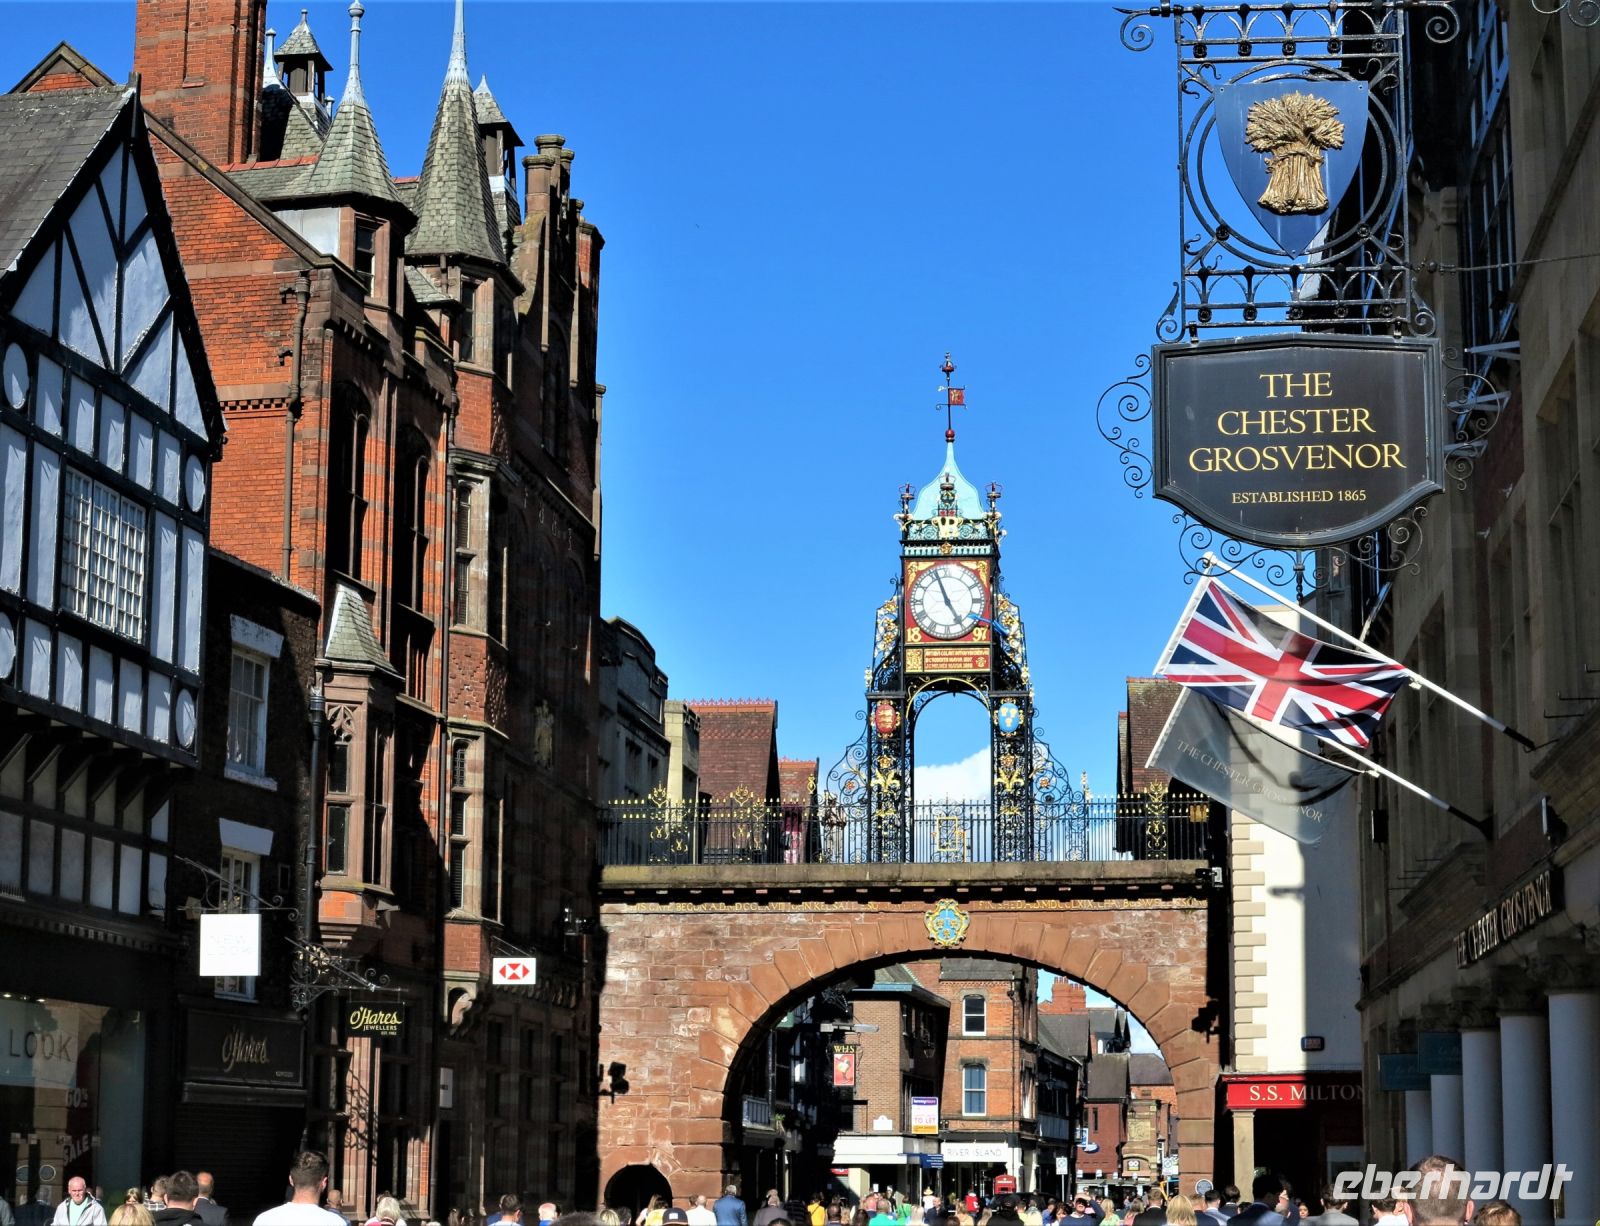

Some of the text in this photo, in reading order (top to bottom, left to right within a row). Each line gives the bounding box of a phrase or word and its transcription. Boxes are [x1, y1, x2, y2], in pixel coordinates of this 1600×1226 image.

[1259, 372, 1333, 399] THE
[1217, 407, 1376, 436] CHESTER
[1188, 443, 1407, 472] GROSVENOR
[1231, 489, 1367, 504] ESTABLISHED 1865
[906, 625, 988, 642] 18 97
[1177, 740, 1199, 760] THE
[1200, 754, 1251, 787] CHESTER
[1468, 908, 1500, 960] CHESTER
[350, 1006, 402, 1029] O'Hares
[9, 1029, 73, 1062] LOOK
[1249, 1084, 1283, 1101] S.S.
[946, 1148, 1002, 1157] RIVER ISLAND
